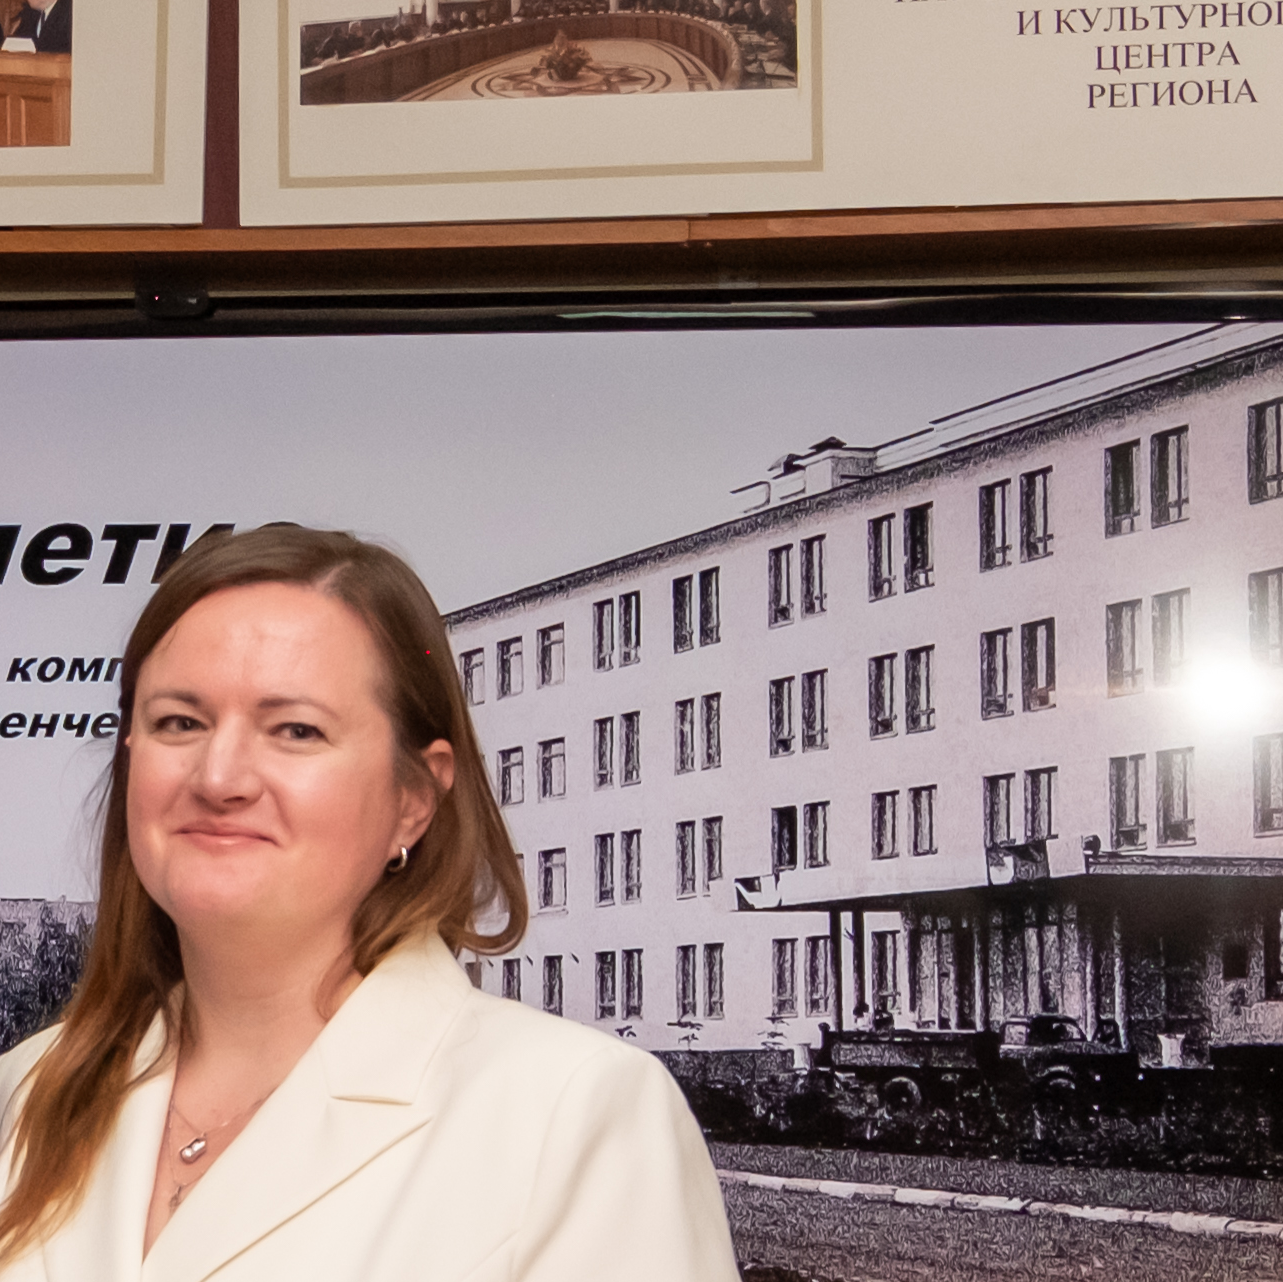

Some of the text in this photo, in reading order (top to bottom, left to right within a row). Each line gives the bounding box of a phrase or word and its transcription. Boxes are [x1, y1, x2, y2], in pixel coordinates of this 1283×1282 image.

[1016, 9, 1043, 36] И
[1095, 41, 1241, 75] ЦЕНТРА
[1087, 78, 1259, 109] РЕГИОНА
